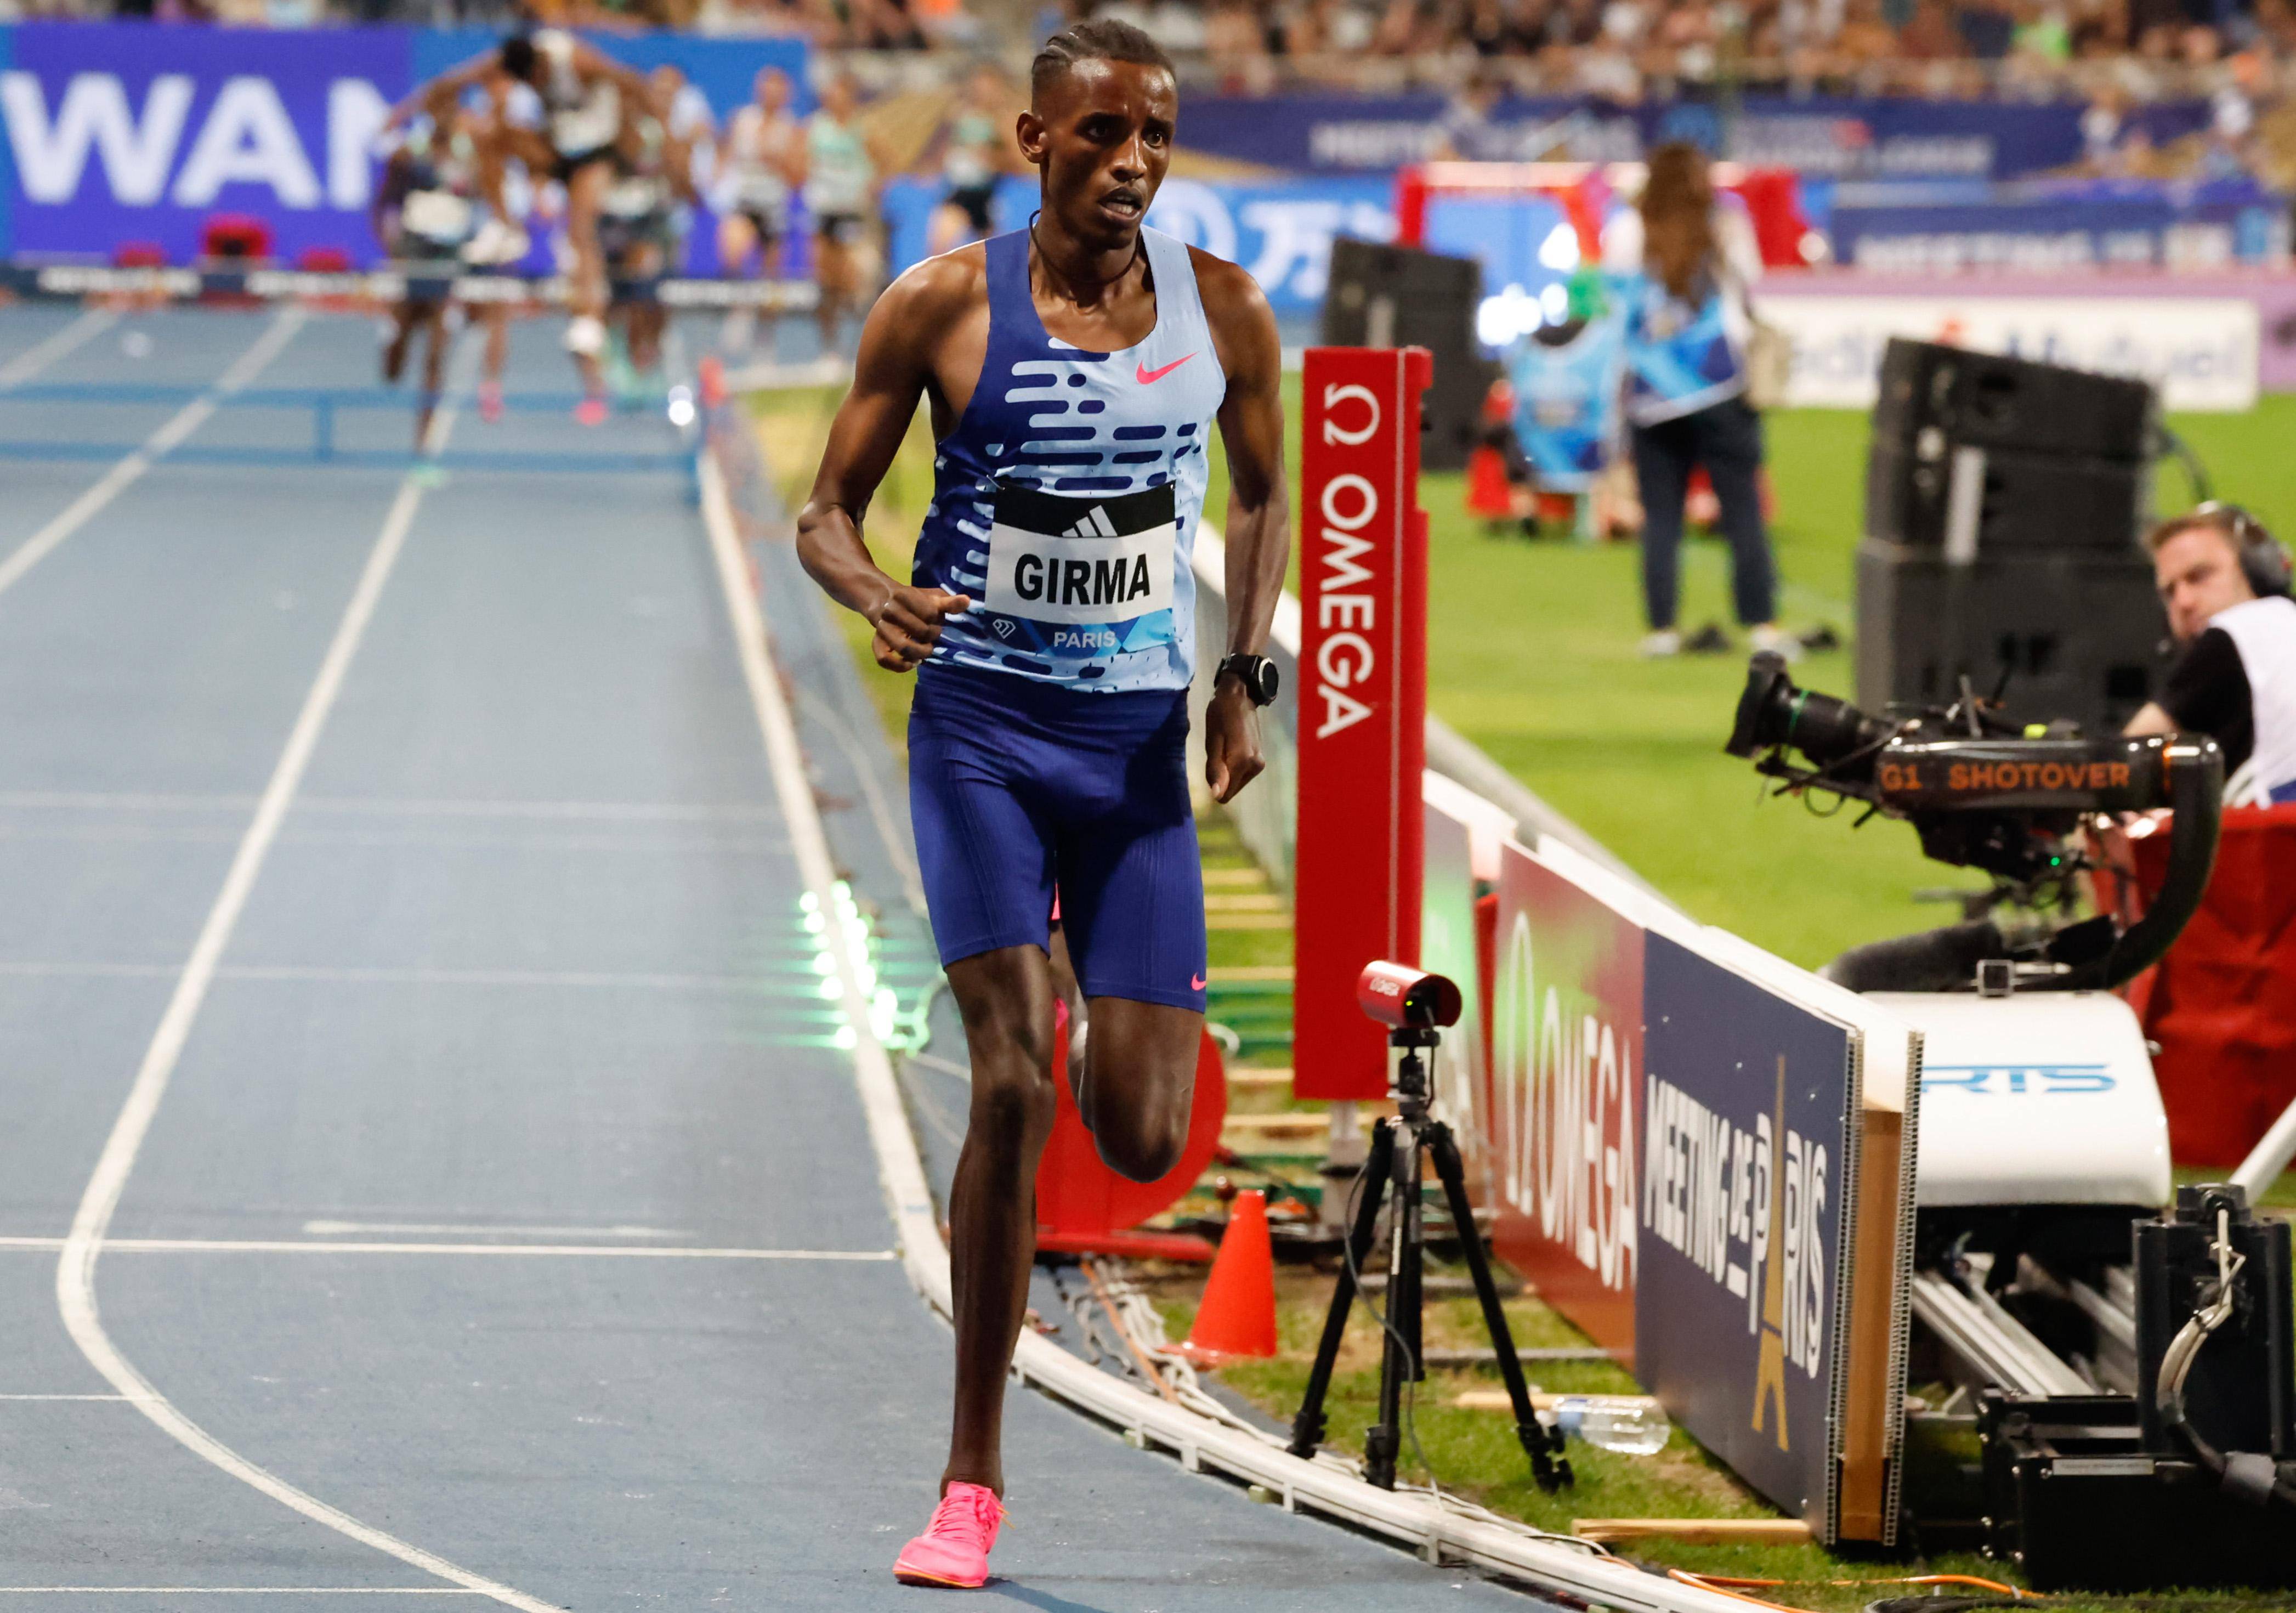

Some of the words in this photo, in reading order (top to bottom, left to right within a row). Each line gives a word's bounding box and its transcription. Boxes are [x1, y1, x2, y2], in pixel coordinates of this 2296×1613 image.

[1014, 553, 1150, 605] GIRMA
[1053, 631, 1116, 648] PARIS
[1317, 474, 1378, 739] OMEGA
[1948, 761, 2130, 790] SHOTOVER
[1539, 985, 1639, 1292] OMEGA
[1645, 1074, 1730, 1284] MEETING
